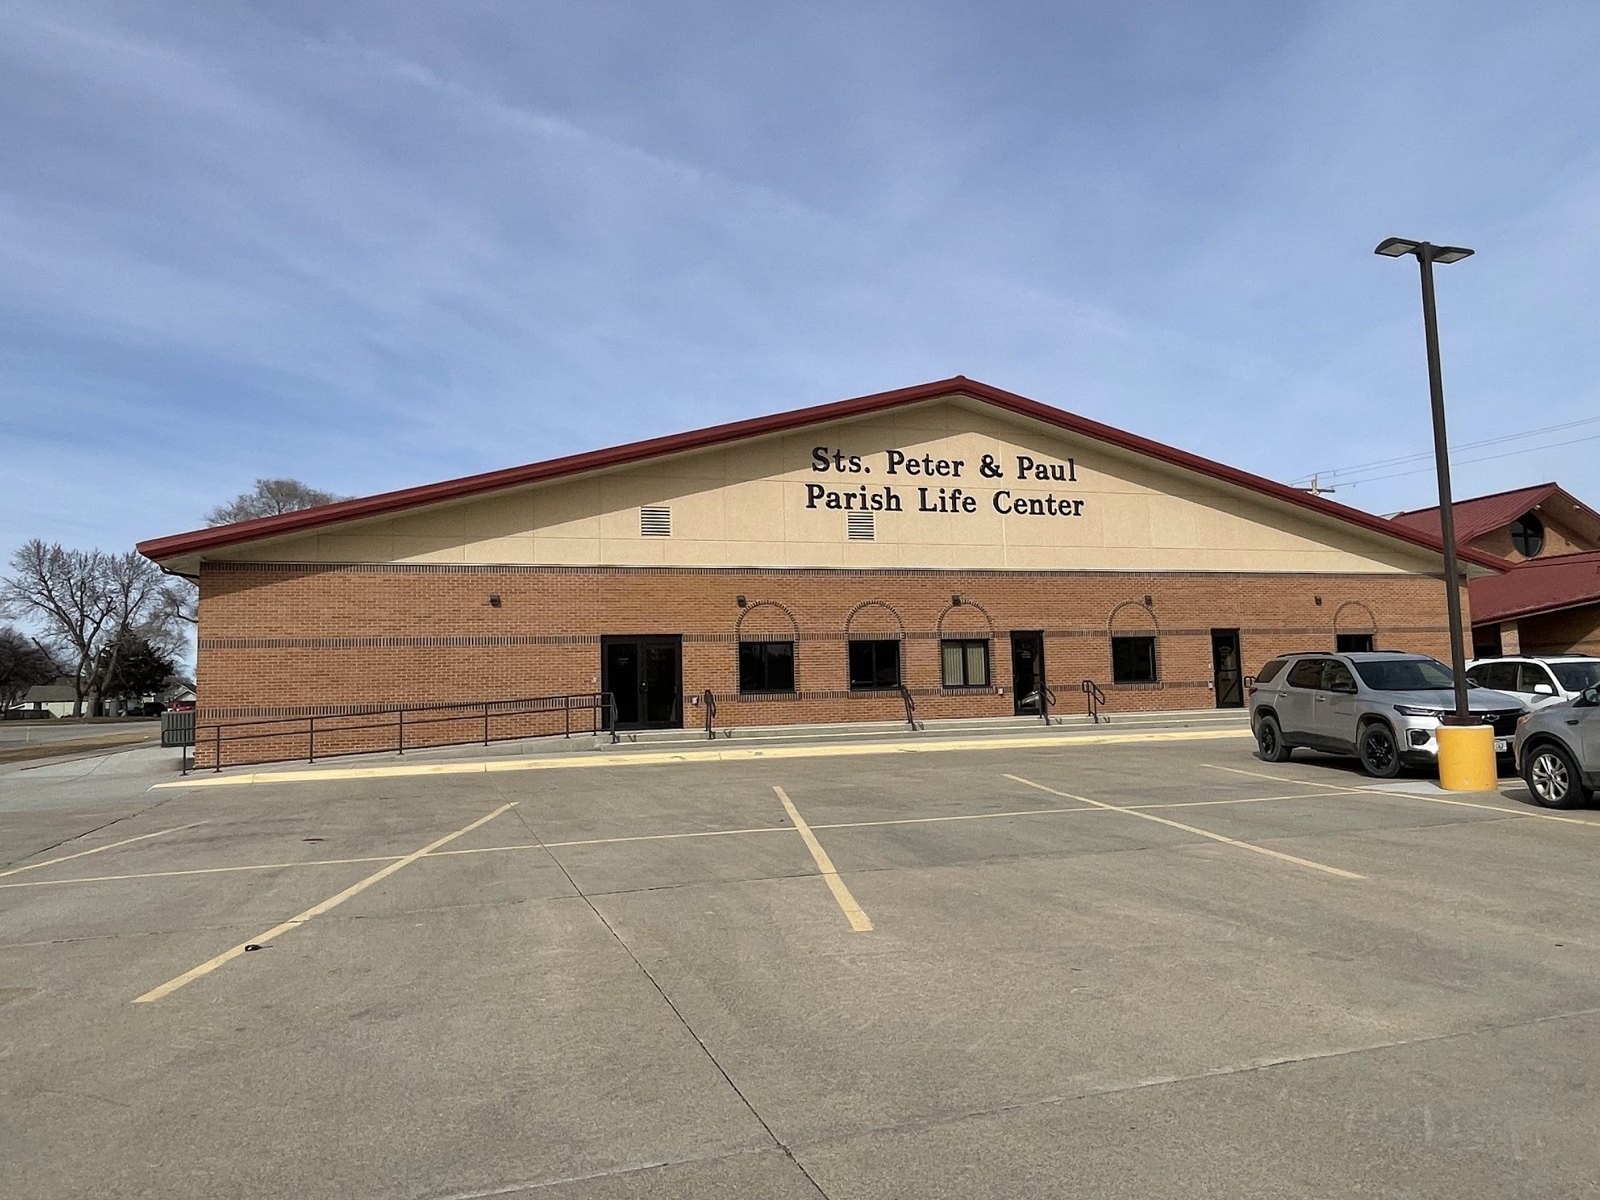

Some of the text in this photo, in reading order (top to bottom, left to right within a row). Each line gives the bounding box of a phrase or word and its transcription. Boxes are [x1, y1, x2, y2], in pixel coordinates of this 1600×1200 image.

[811, 447, 1077, 481] Sts. Peter & Paul
[805, 484, 1084, 516] Parish Life Center
